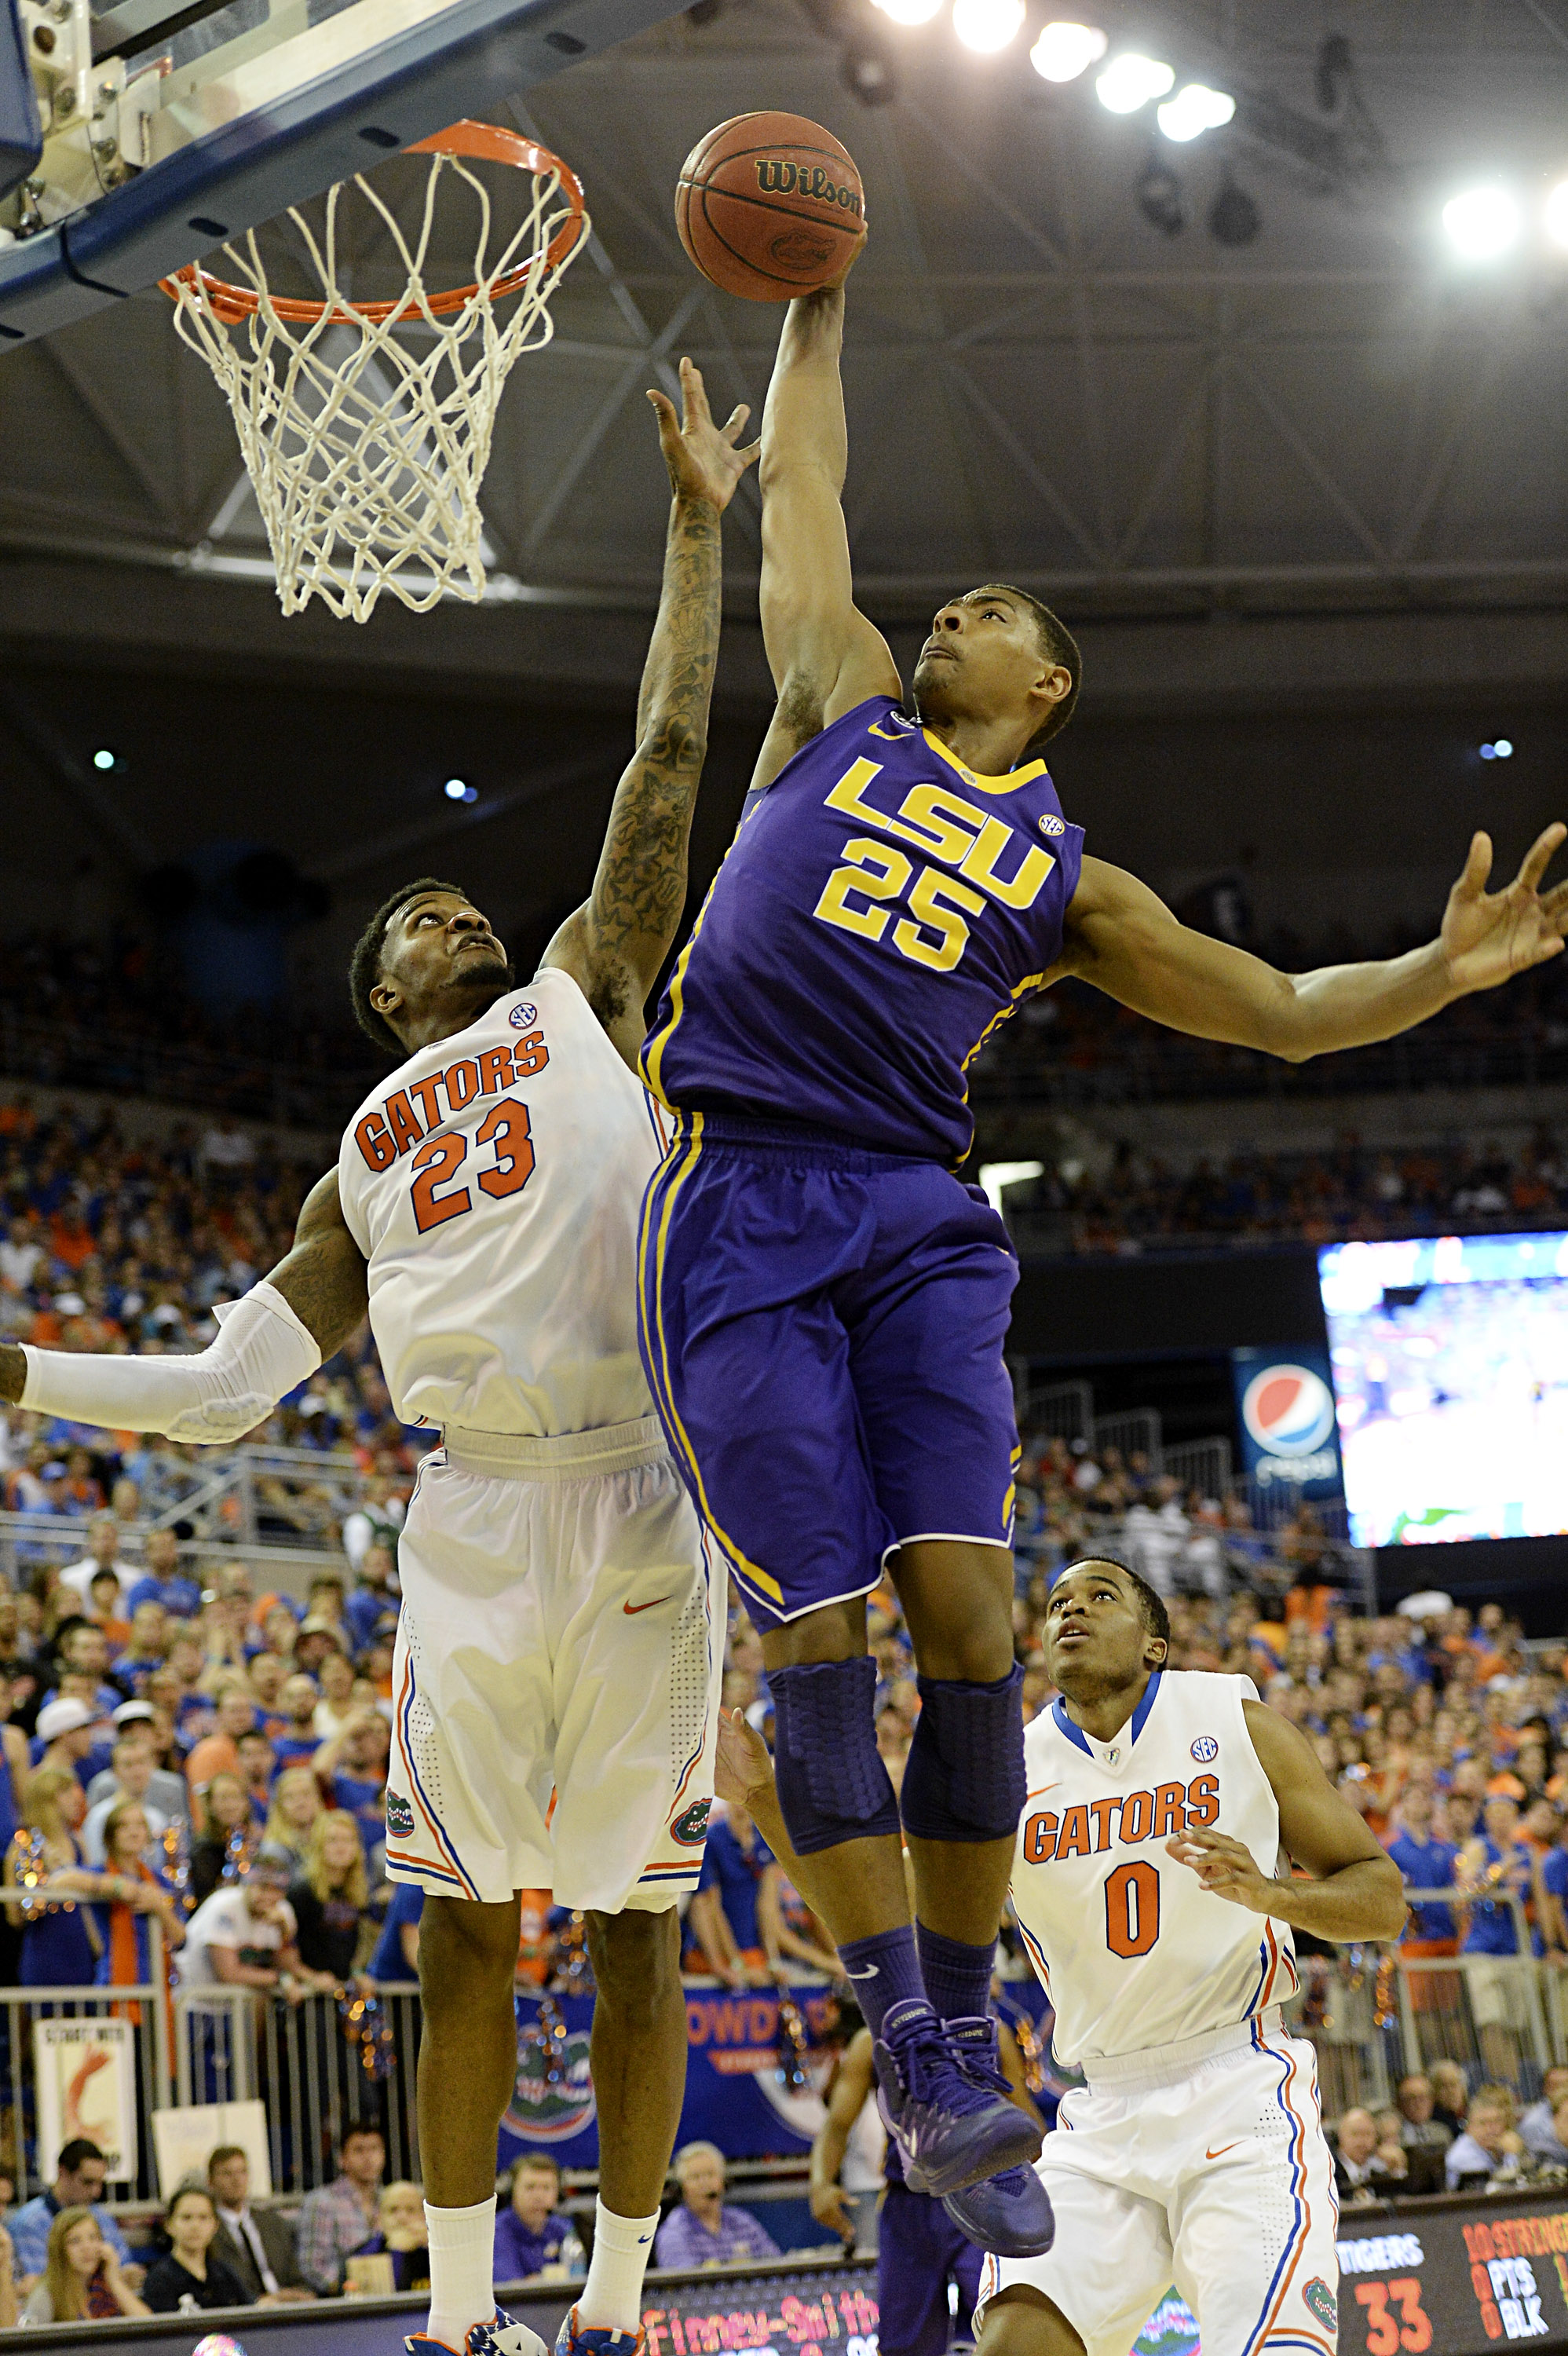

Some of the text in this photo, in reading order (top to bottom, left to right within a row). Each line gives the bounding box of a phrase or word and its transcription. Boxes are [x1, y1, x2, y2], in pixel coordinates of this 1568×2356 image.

[755, 159, 861, 218] Wilson
[824, 755, 1056, 910] LSU
[1041, 814, 1063, 834] SEC
[813, 837, 987, 971] 25
[511, 1004, 536, 1027] SEC
[354, 1030, 550, 1173] GATORS
[410, 1096, 535, 1235] 23
[1192, 1737, 1217, 1762] SEC
[1023, 1773, 1219, 1865] GATORS
[1104, 1860, 1160, 1959] 0
[685, 1999, 785, 2045] OWD
[1336, 2233, 1425, 2275] TIGERS
[1487, 2255, 1537, 2300] PTS
[1354, 2277, 1433, 2356] 33
[1499, 2295, 1550, 2340] BLK
